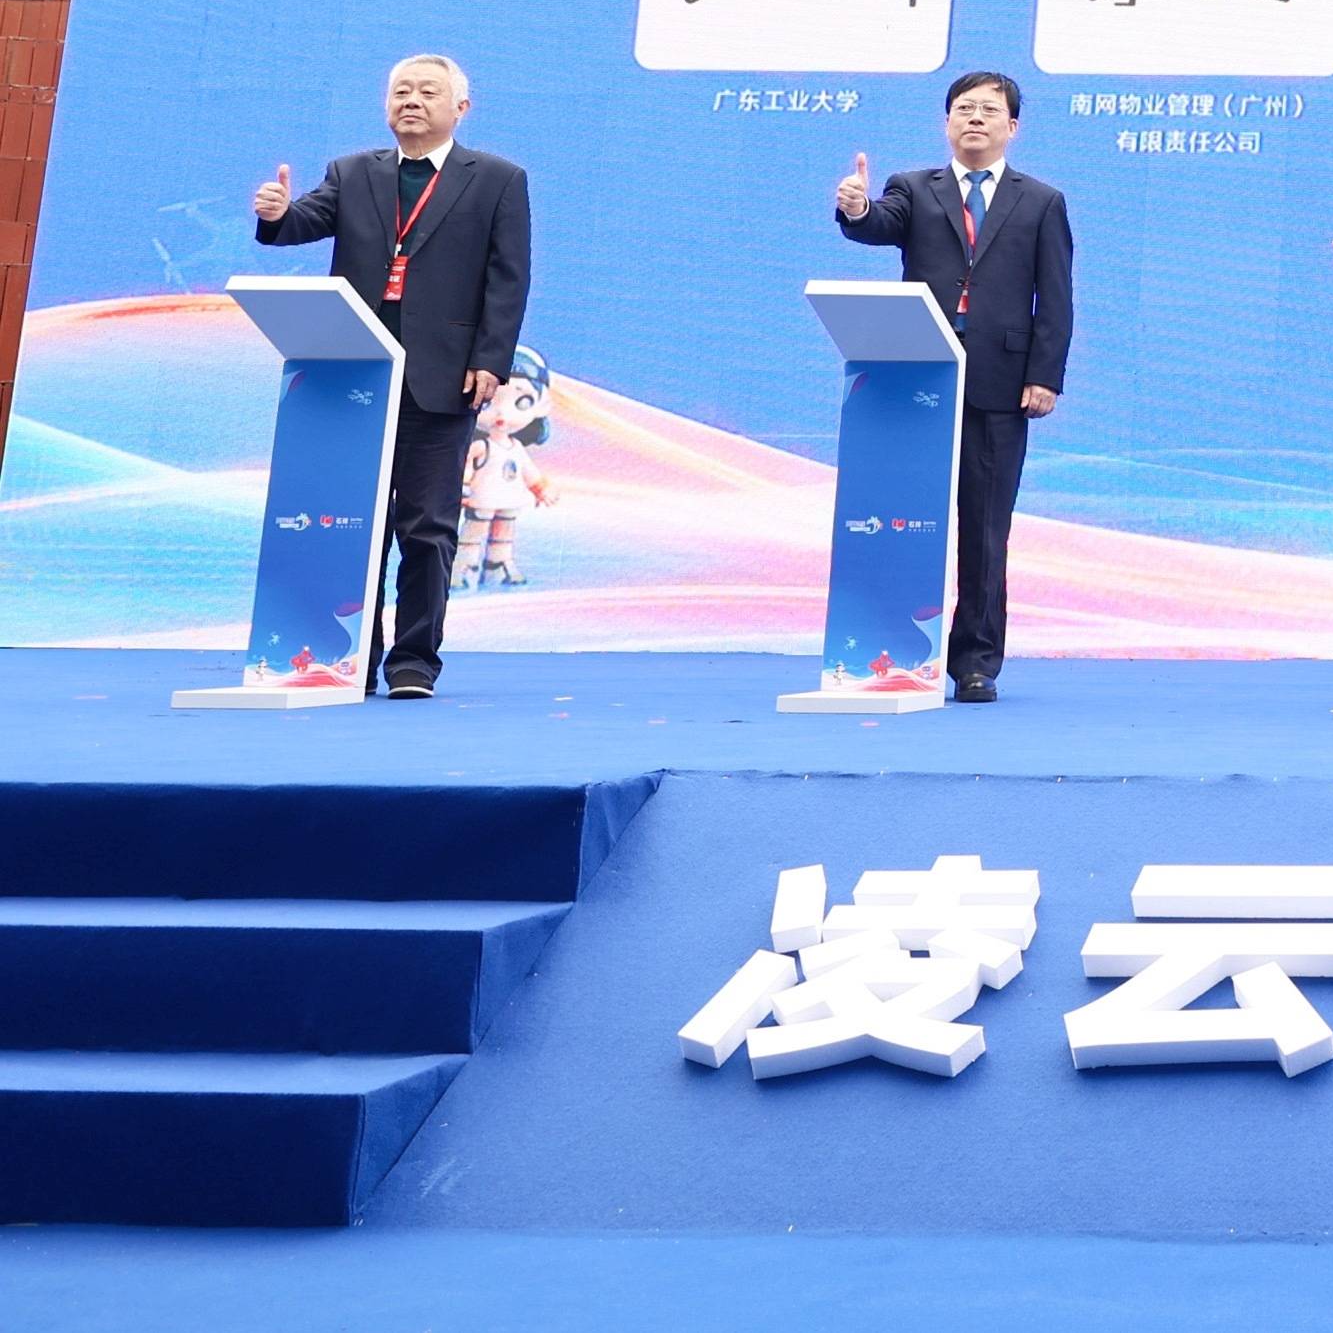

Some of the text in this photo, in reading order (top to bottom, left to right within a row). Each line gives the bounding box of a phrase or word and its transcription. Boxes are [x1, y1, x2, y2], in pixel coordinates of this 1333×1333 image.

[713, 89, 860, 113] 广东工业大学
[1117, 130, 1261, 154] 有限责任公司
